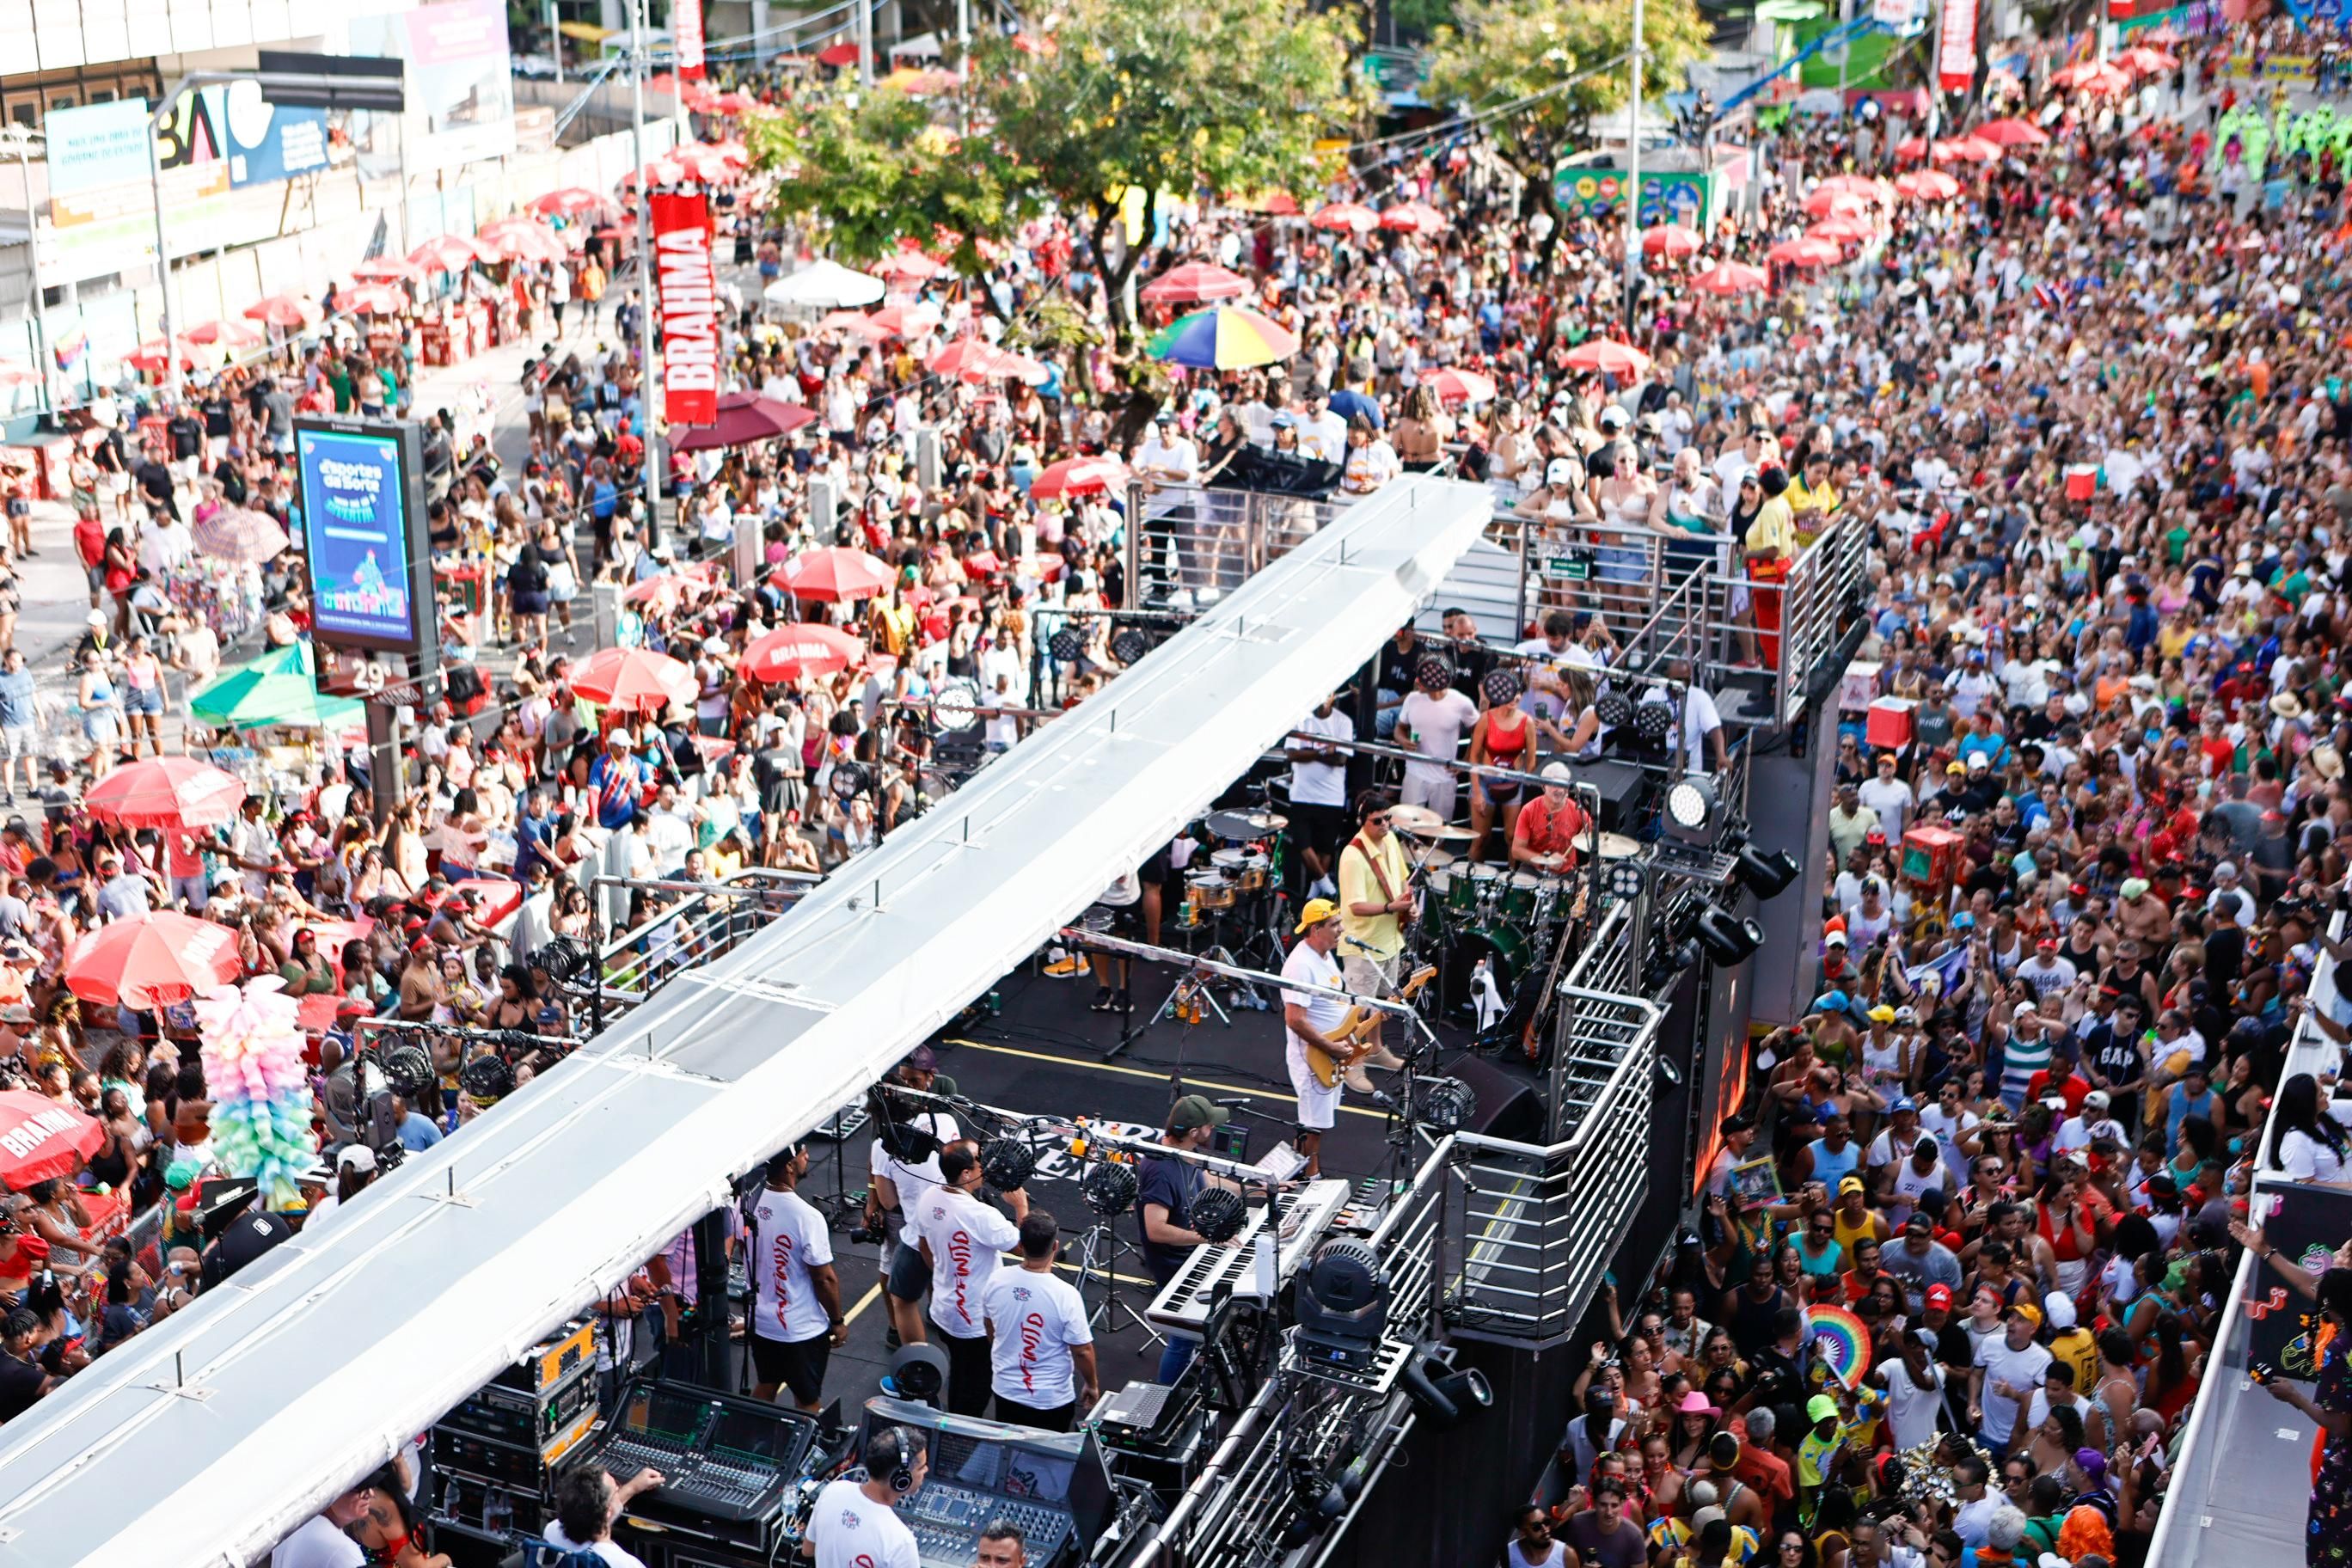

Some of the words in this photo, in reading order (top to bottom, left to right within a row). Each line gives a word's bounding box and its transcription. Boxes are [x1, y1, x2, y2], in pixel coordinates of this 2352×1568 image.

[657, 226, 716, 392] BRAHMA
[769, 642, 831, 665] BRAHMA
[2100, 1046, 2135, 1068] GAP
